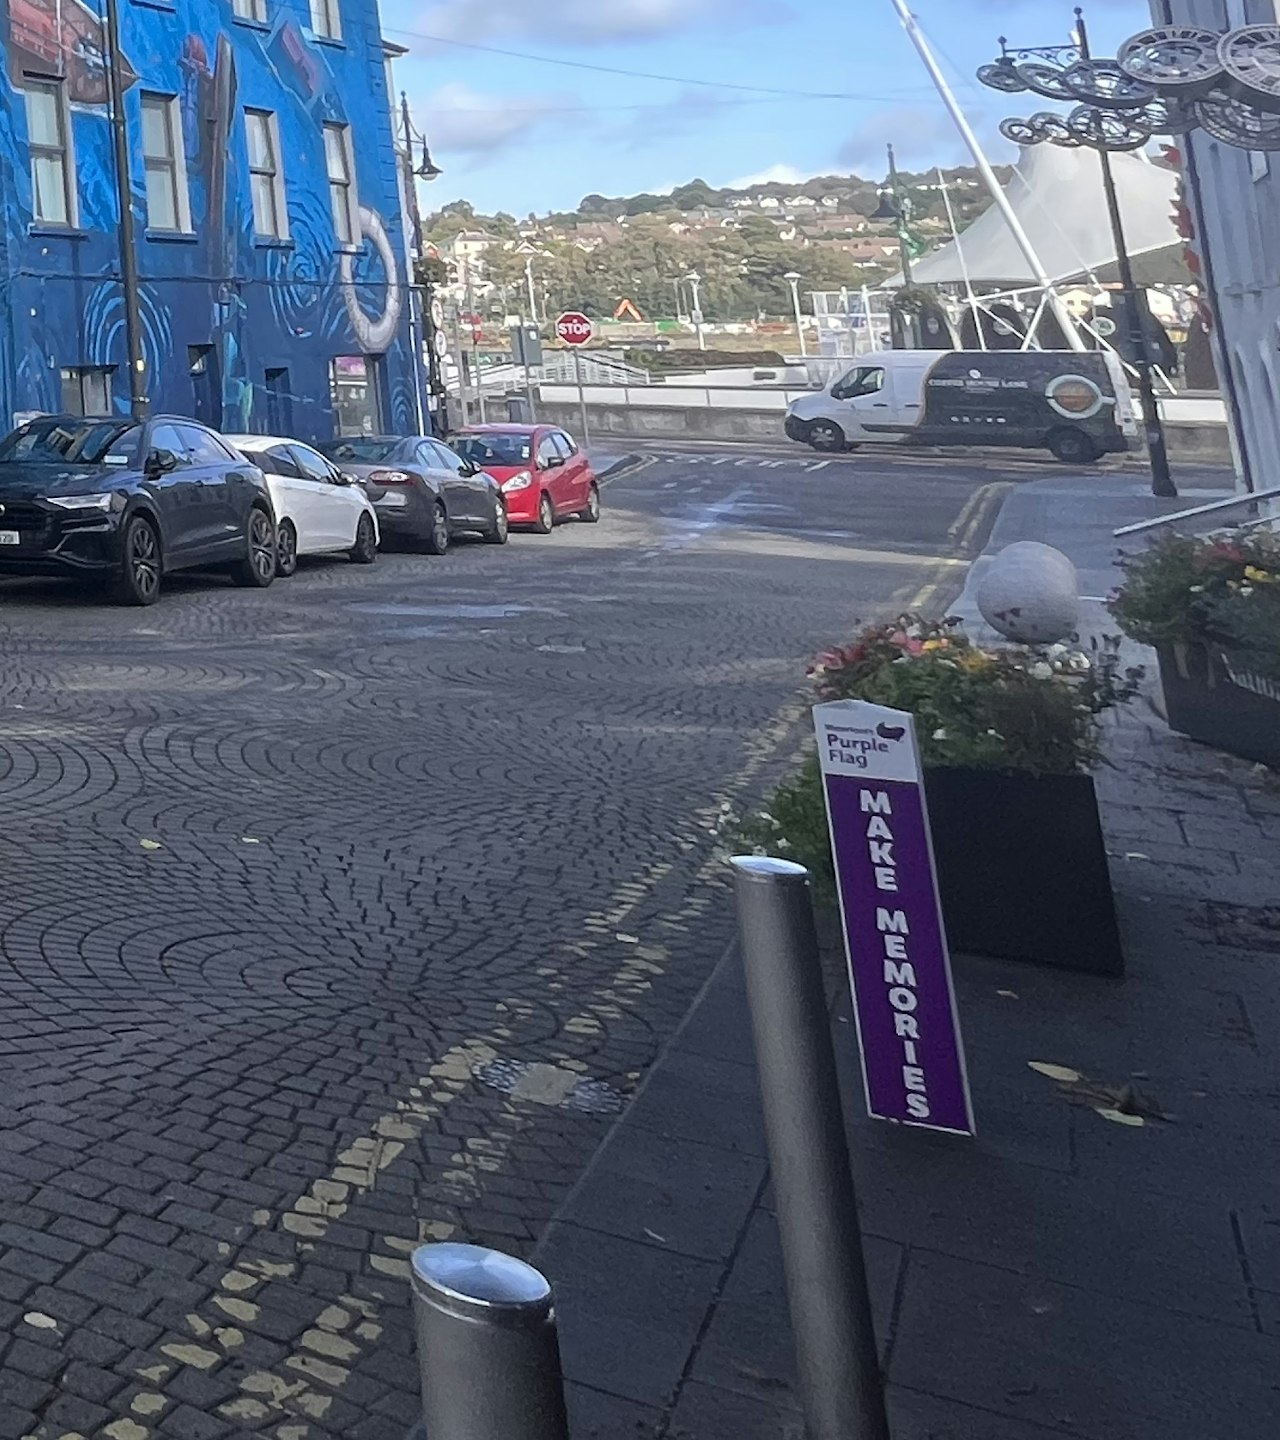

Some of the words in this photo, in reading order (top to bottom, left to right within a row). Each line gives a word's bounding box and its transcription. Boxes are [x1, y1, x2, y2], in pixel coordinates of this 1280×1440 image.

[558, 322, 591, 335] STOP
[826, 733, 889, 754] Purple
[829, 749, 868, 768] Flag
[859, 789, 899, 892] MAKE
[876, 906, 931, 1119] MEMORIES
